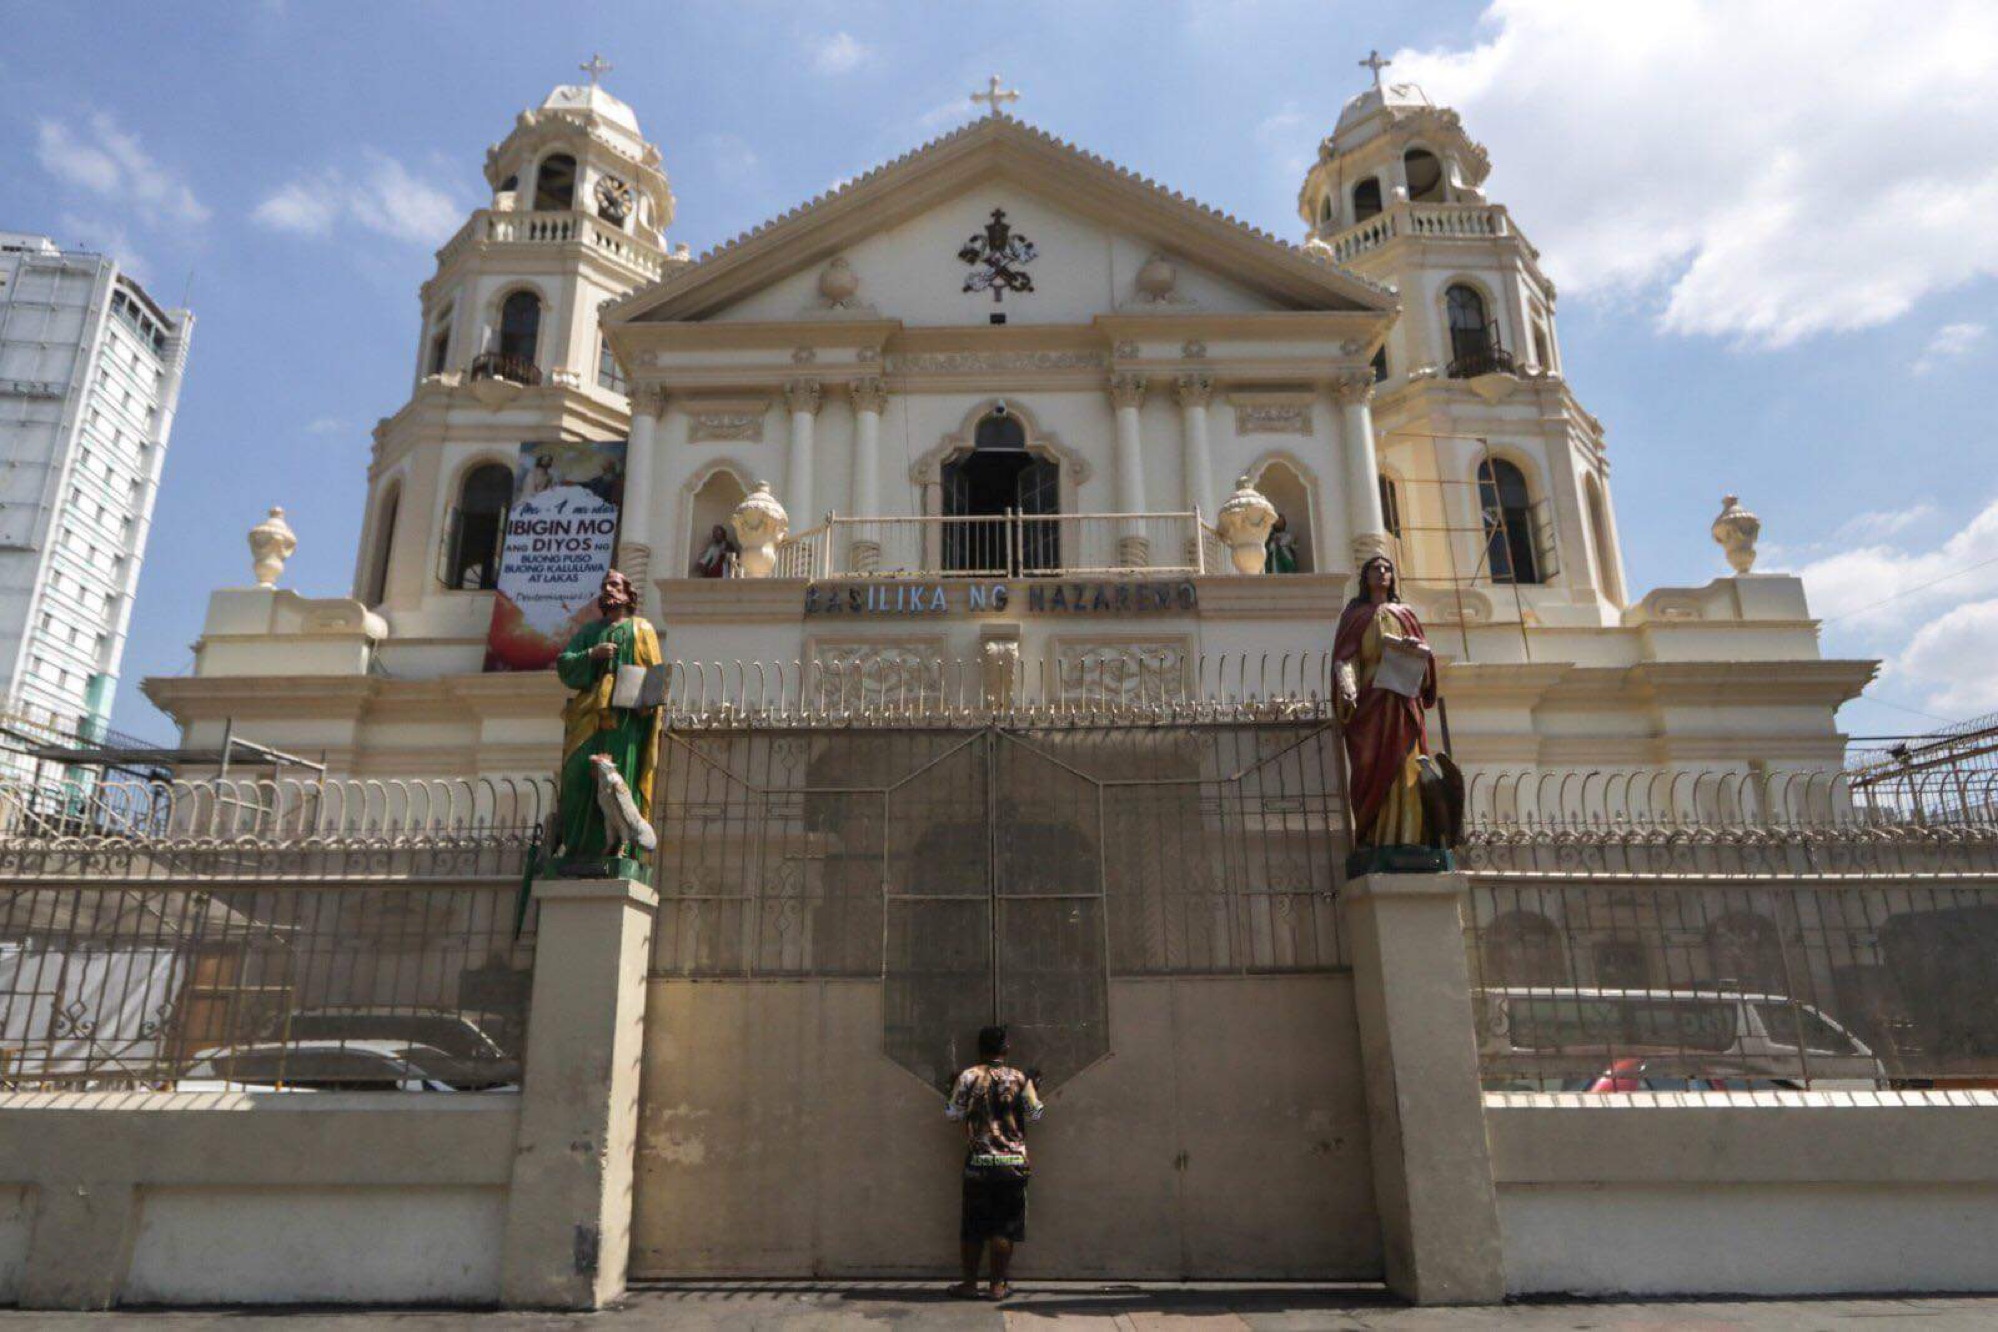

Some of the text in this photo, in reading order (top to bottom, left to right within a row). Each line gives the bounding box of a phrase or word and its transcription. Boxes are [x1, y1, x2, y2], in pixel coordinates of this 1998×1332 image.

[507, 519, 615, 535] IBIGIN MO
[506, 544, 528, 552] ANG
[532, 538, 592, 552] DIYOS
[521, 554, 592, 563] BUONG PUSO
[504, 563, 605, 573] BUONG KALULUWA
[528, 573, 579, 583] AT LAKAS
[806, 584, 947, 613] BASILIKA
[969, 584, 1008, 613] NG
